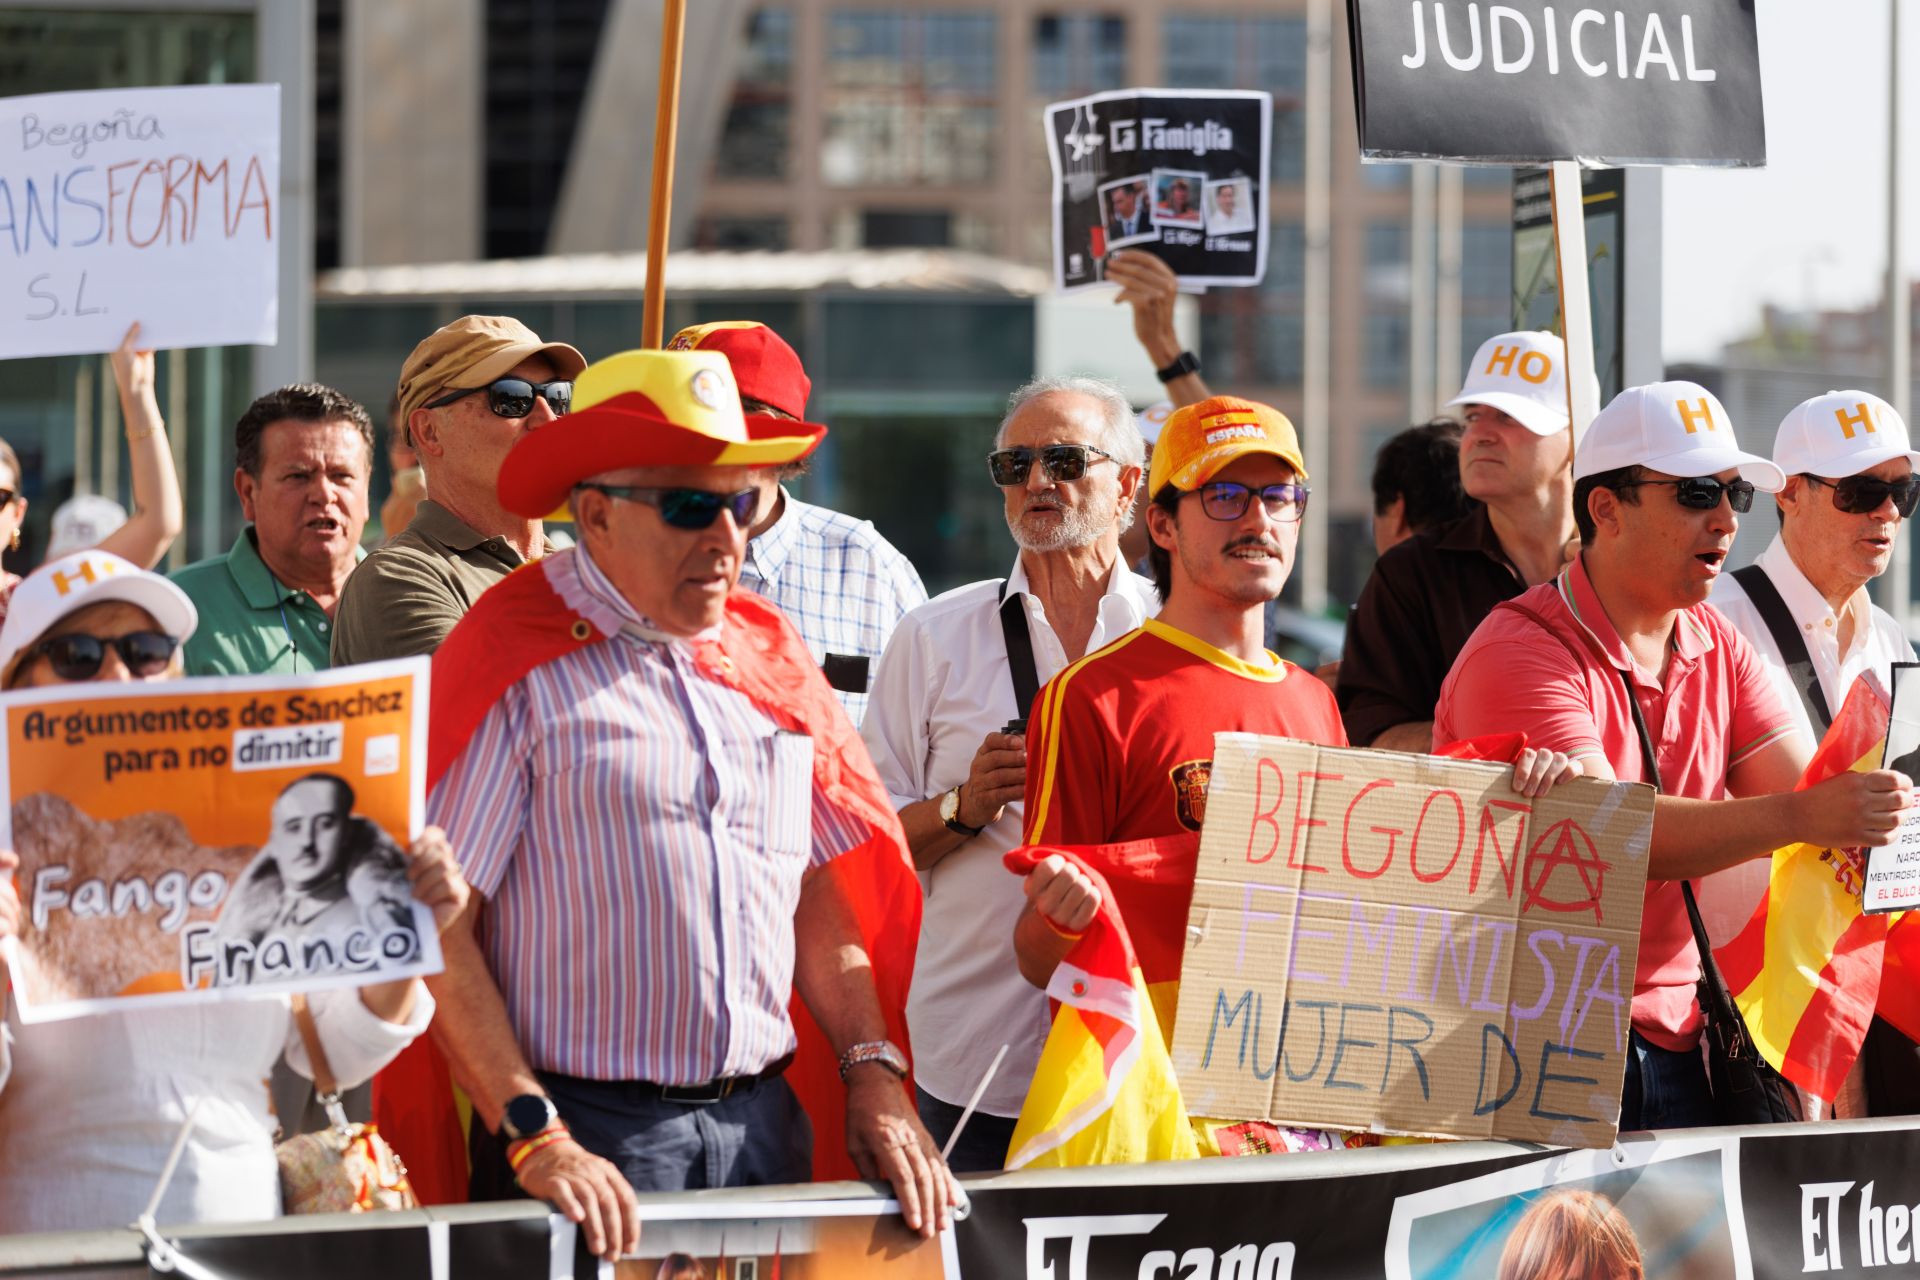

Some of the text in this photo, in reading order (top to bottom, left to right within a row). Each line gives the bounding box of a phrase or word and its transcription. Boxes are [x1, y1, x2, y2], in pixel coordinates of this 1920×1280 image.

[1402, 0, 1717, 82] JUDICIAL
[21, 107, 165, 159] Begoña
[1109, 117, 1233, 157] La Famiglia
[24, 269, 109, 321] S.L.
[1485, 345, 1553, 385] HO
[1206, 424, 1268, 445] ESPAÑA
[23, 703, 231, 746] Argumentos
[240, 696, 276, 727] de
[104, 730, 338, 783] para no dimitir
[31, 864, 228, 933] Fango
[1870, 869, 1917, 882] MENTIROSO
[1878, 885, 1916, 900] EL BULO
[181, 920, 421, 992] Franco
[1236, 881, 1627, 1061] FEMINISTA
[1202, 987, 1607, 1123] MUJER DE
